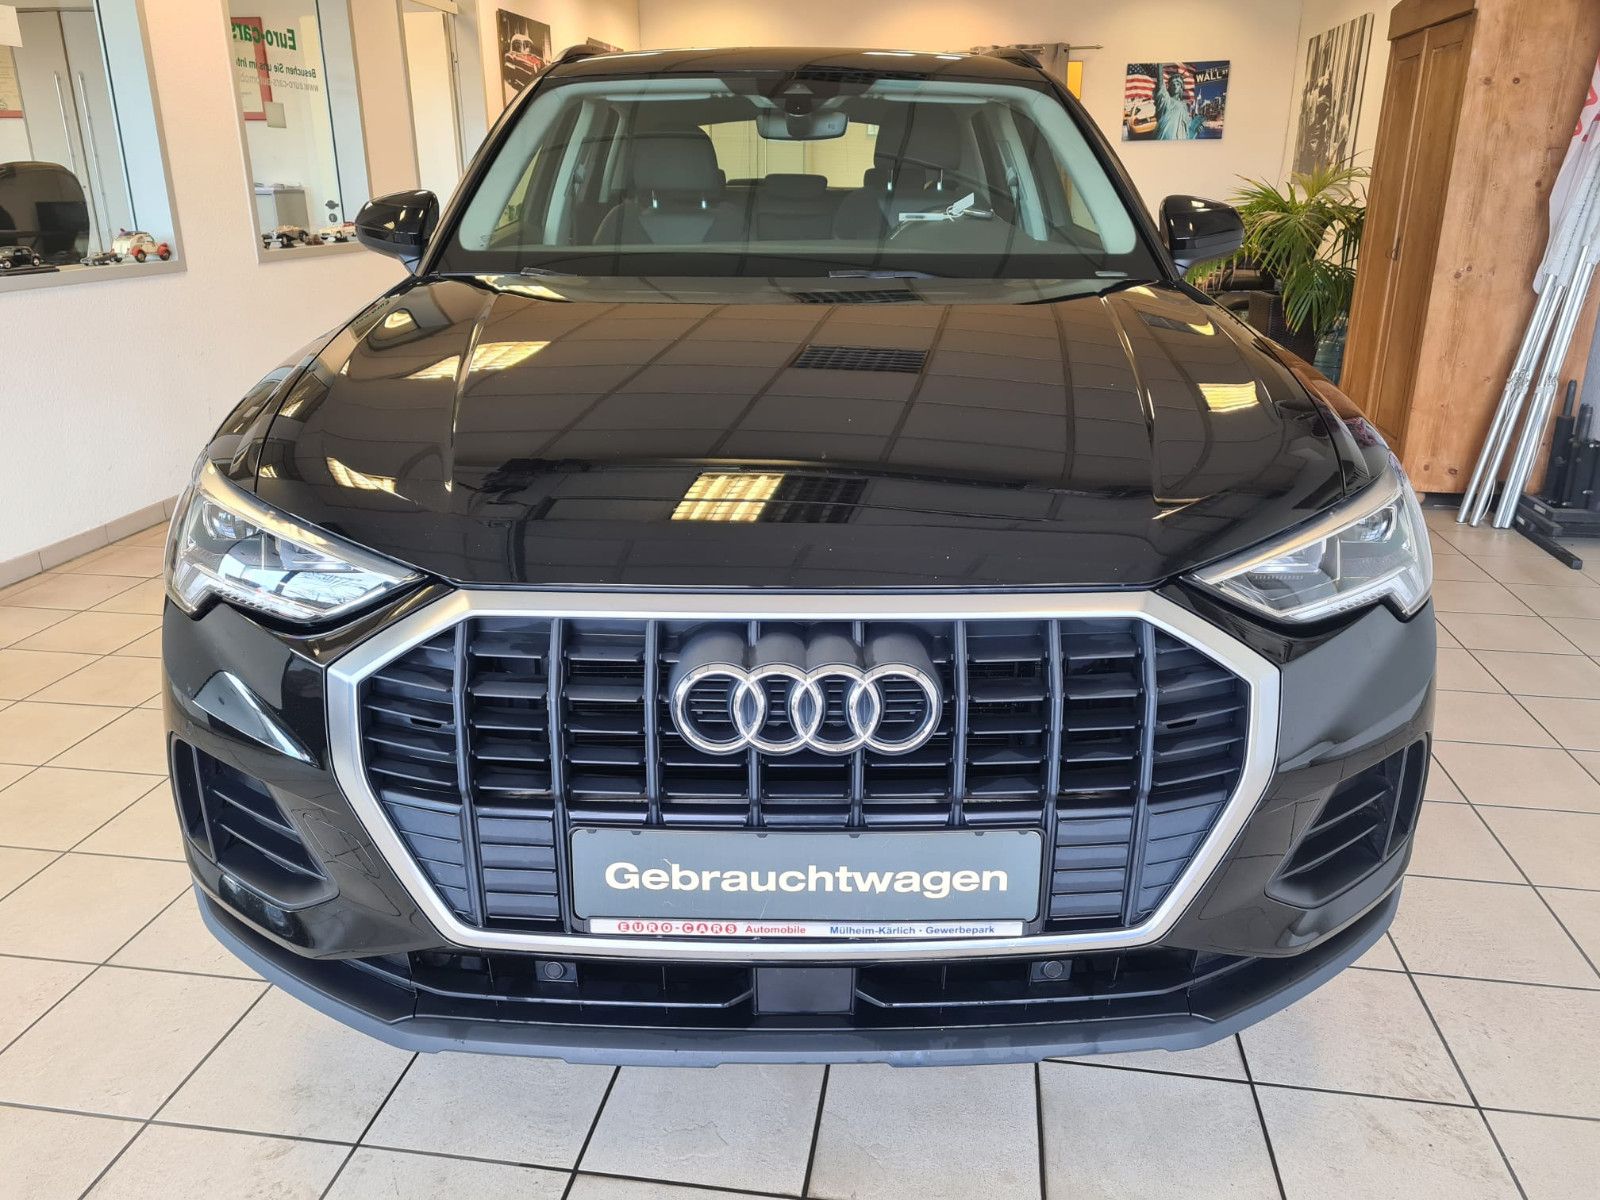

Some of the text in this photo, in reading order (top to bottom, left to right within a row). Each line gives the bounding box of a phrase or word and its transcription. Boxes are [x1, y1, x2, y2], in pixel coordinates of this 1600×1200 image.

[1196, 71, 1222, 82] WALL
[605, 862, 1008, 898] Gebrauchtwagen
[618, 921, 995, 936] EURO-CARS Automobile Mülheim-Kärlich Gewerbepark
